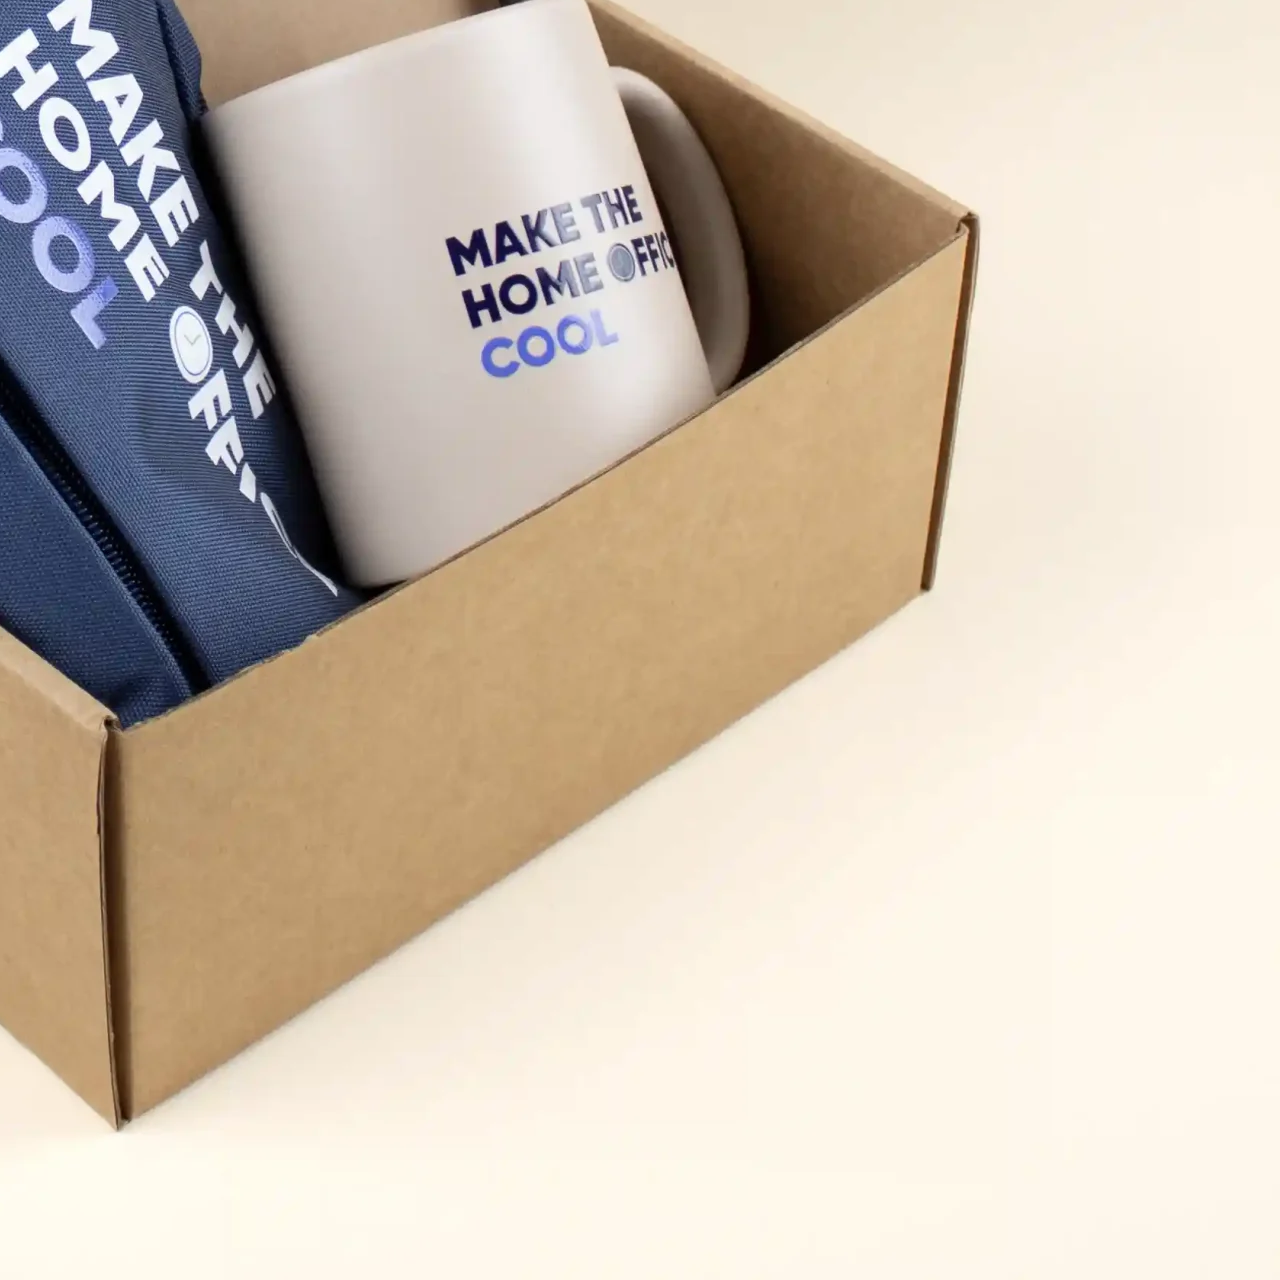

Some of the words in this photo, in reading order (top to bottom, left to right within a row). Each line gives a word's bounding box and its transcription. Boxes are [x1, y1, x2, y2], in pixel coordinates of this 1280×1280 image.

[445, 201, 581, 277] MAKE
[580, 184, 643, 233] THE
[461, 252, 604, 329] HOME
[606, 230, 677, 283] OFFIC
[188, 240, 277, 420] THE
[481, 308, 619, 378] COOL
[169, 305, 338, 597] OFFI
